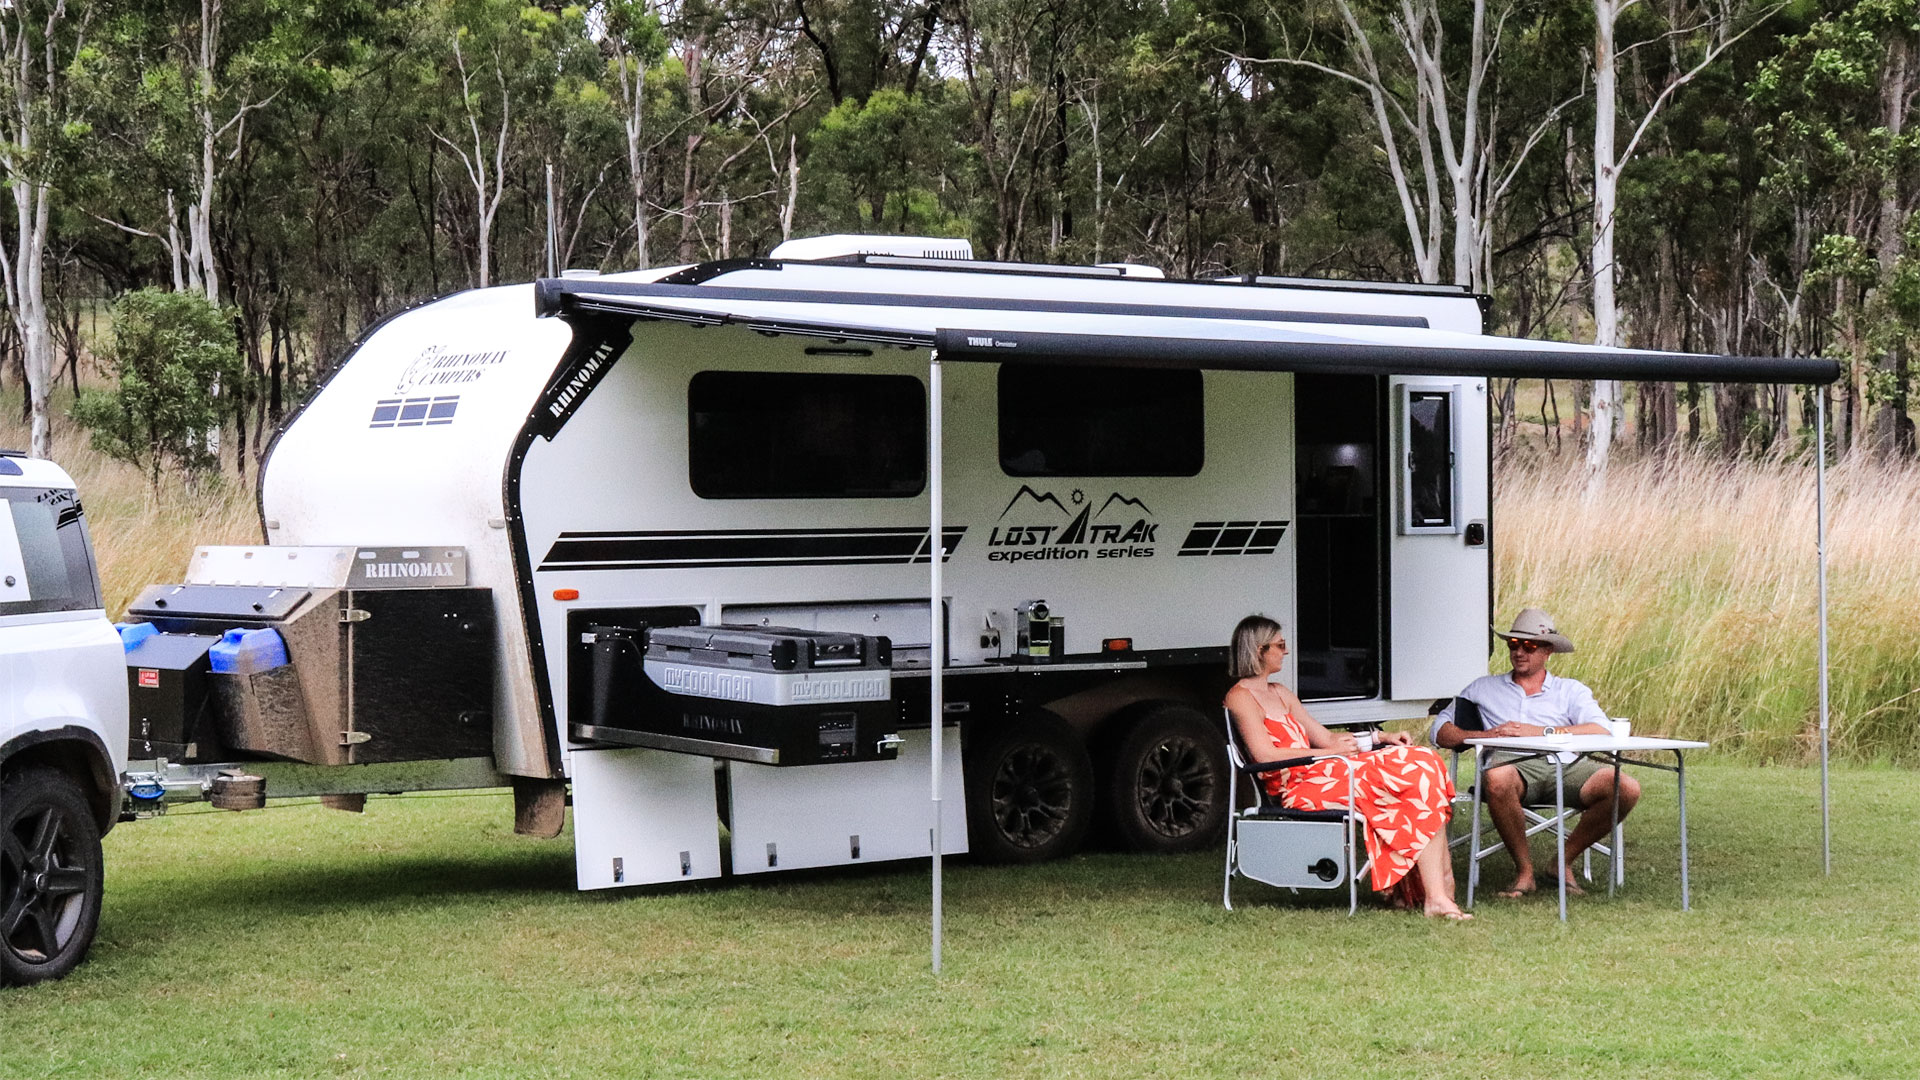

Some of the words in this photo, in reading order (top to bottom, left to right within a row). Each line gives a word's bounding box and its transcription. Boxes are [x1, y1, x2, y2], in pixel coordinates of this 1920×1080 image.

[967, 336, 993, 347] THULE
[432, 350, 508, 369] RHINOMAX
[418, 368, 483, 386] CAMPERS
[549, 343, 614, 418] RHINOMAX
[988, 526, 1059, 546] LOST
[1089, 518, 1159, 544] TRAK
[988, 547, 1089, 563] expedition
[1096, 545, 1154, 559] series
[365, 562, 454, 578] RHINOMAX
